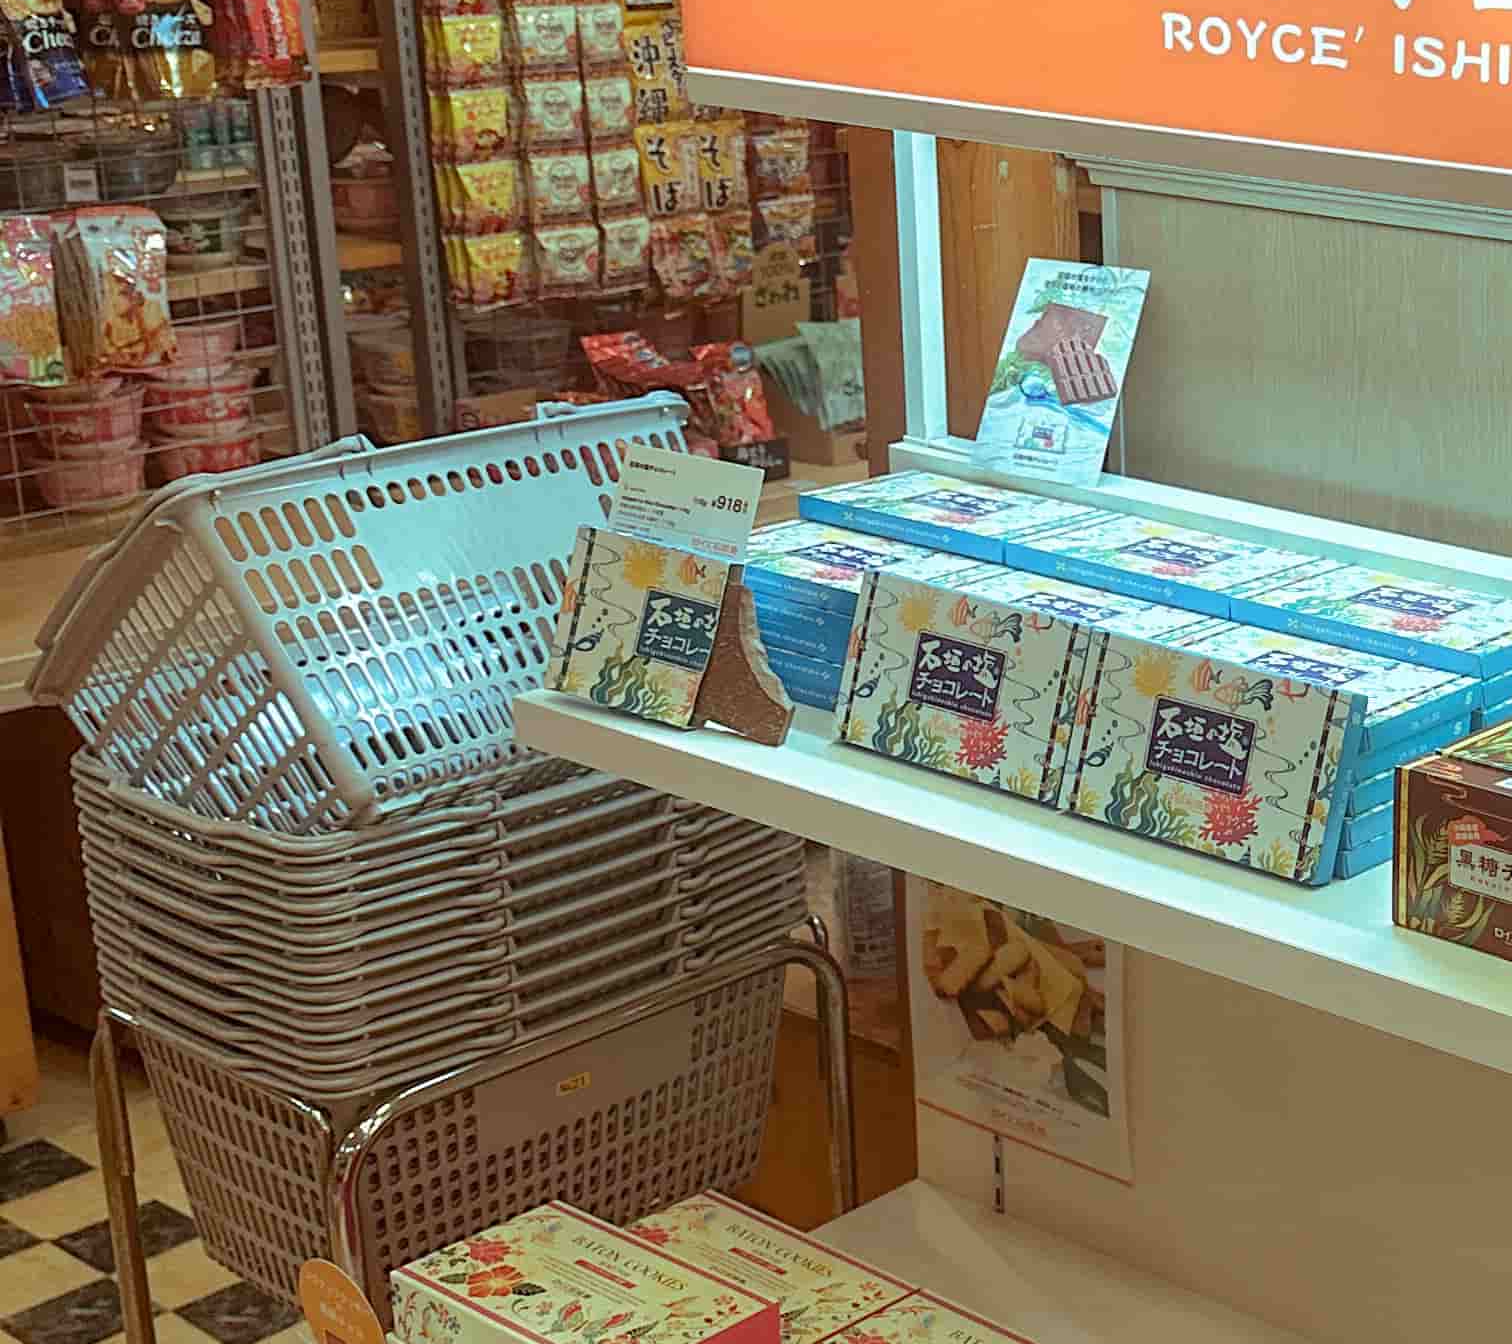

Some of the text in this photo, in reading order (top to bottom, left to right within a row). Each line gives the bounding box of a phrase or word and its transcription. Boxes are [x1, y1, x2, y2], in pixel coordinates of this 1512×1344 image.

[917, 639, 999, 689] 石垣の塩
[915, 672, 993, 707] チョコレート
[1156, 700, 1251, 762] 石垣の塩
[1154, 740, 1244, 780] チョコレート
